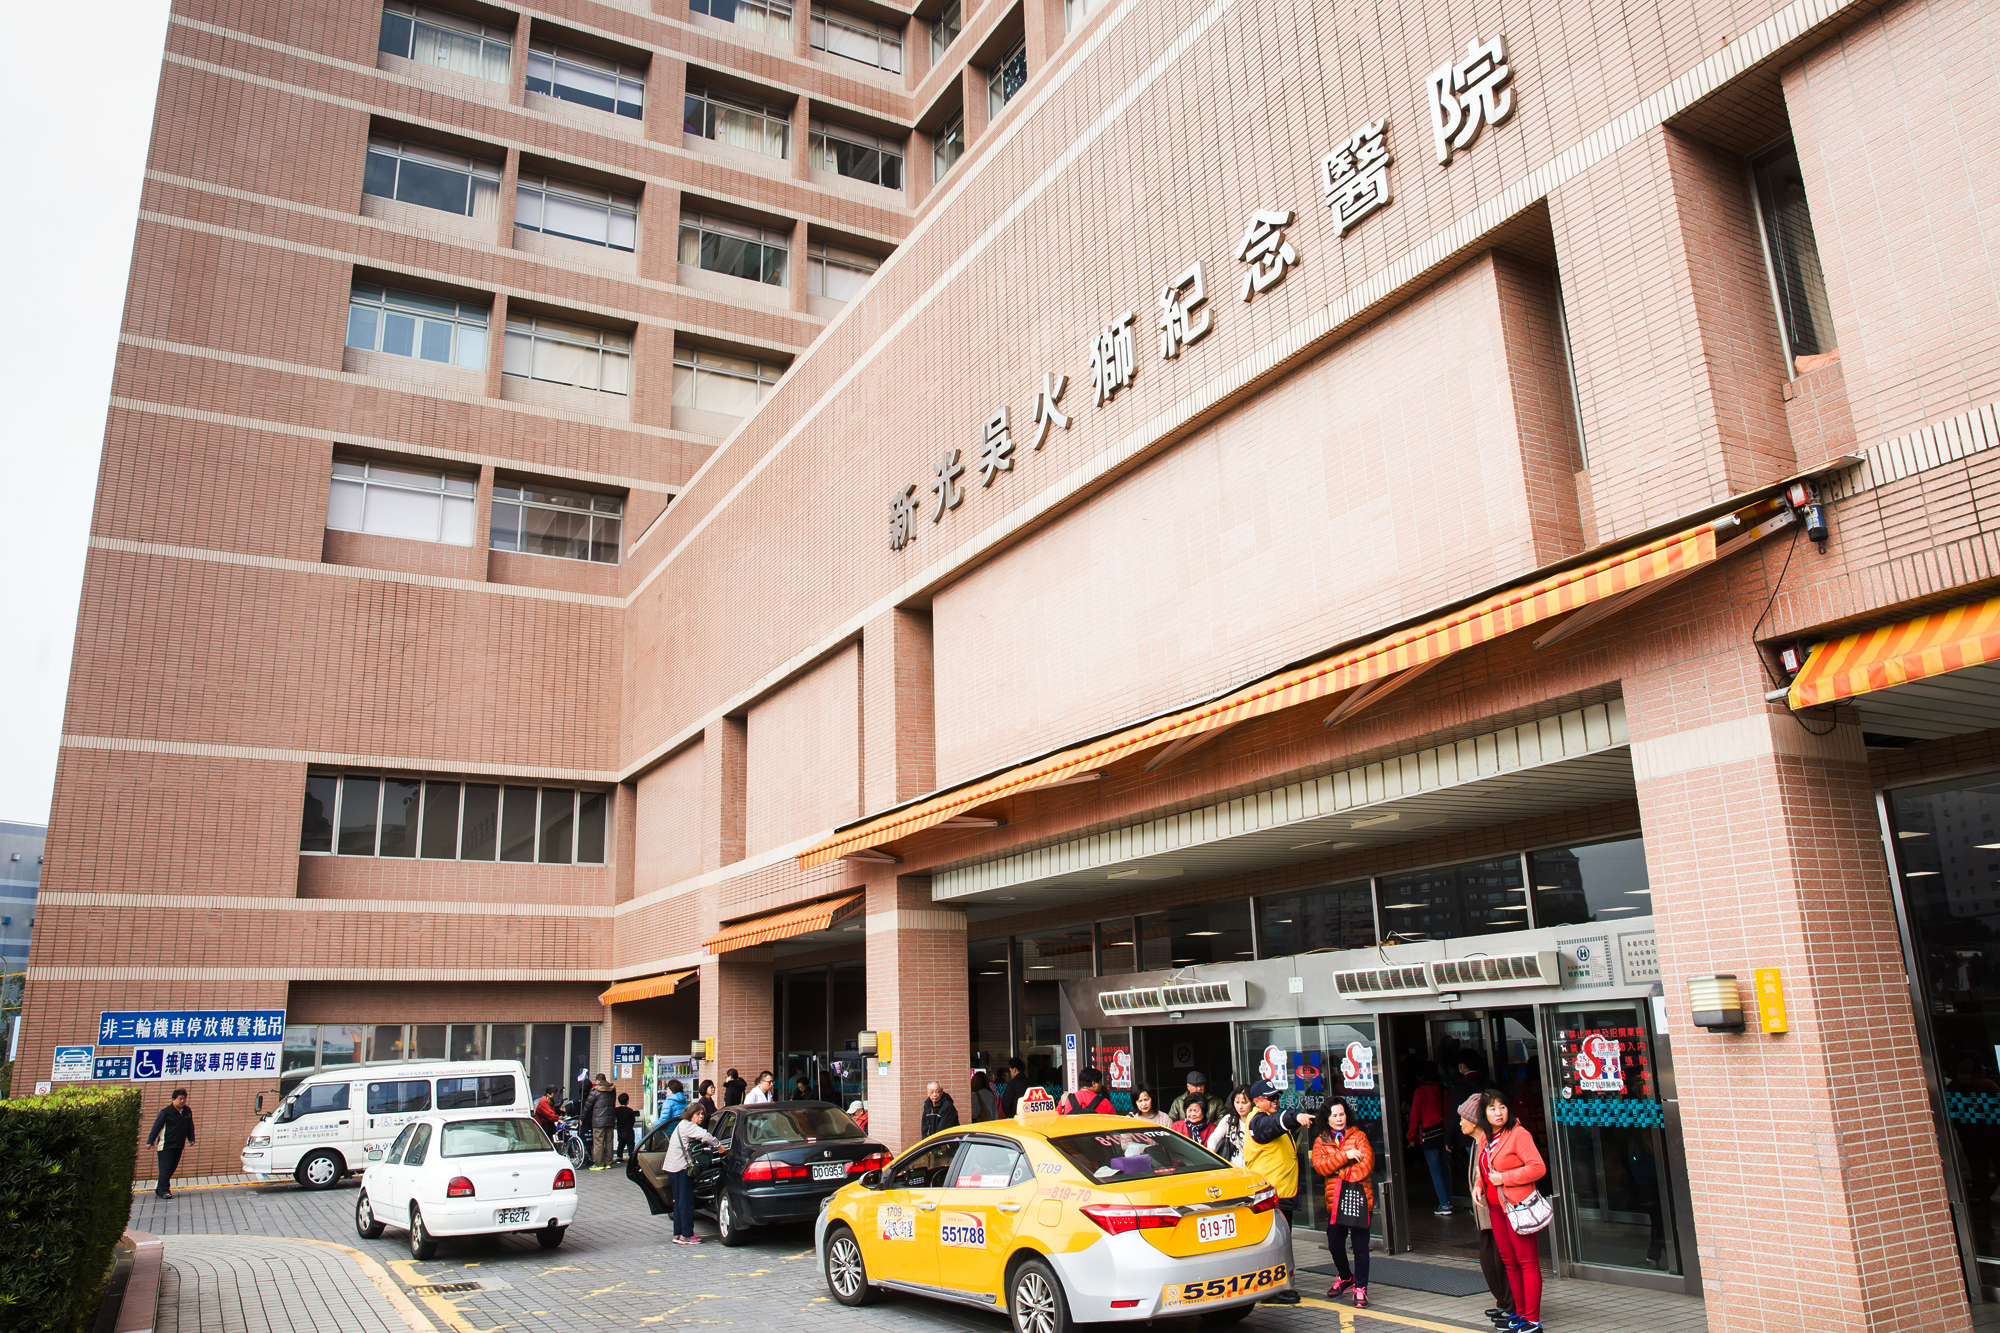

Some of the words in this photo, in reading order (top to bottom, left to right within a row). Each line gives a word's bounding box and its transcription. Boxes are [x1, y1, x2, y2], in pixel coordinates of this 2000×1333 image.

[888, 34, 1517, 552] 新光吳火獅紀念醫院
[1762, 971, 1782, 1029] 來賓下車處
[102, 1016, 282, 1039] 非三輪機車停放報警拖吊
[164, 1051, 276, 1075] 無障礙專用停車位
[1030, 1100, 1054, 1113] 551788
[1036, 1163, 1062, 1175] 1709
[1051, 1186, 1092, 1202] 819-7D
[886, 1207, 902, 1218] 1709
[941, 1225, 985, 1245] 551788
[1200, 1218, 1235, 1239] 819-7D
[1183, 1264, 1287, 1300] 551788
